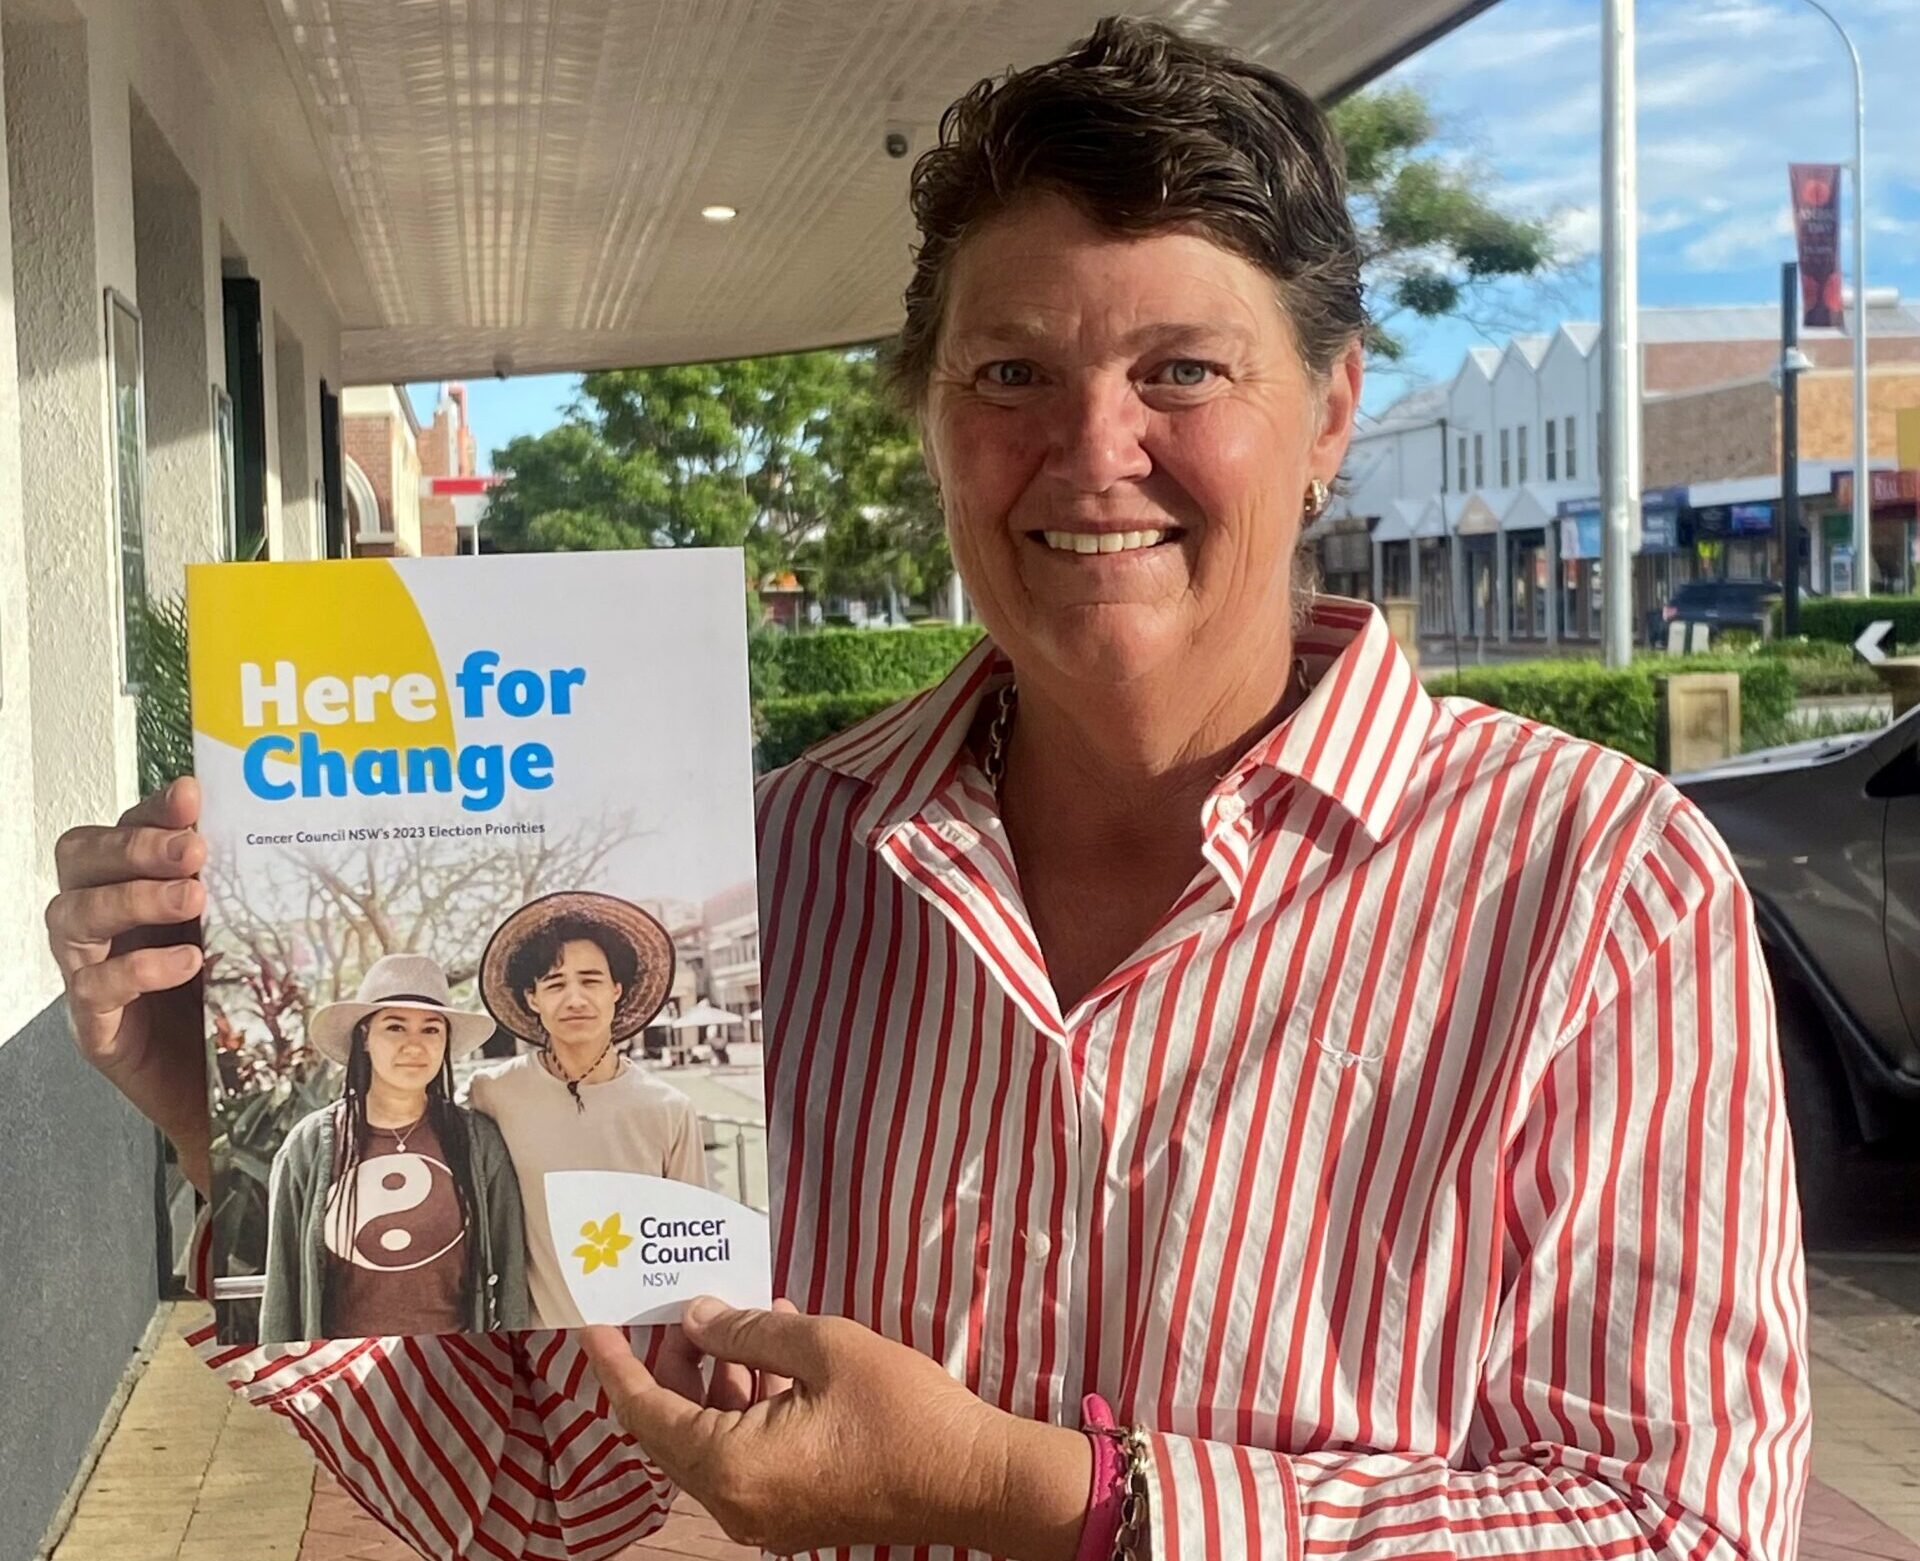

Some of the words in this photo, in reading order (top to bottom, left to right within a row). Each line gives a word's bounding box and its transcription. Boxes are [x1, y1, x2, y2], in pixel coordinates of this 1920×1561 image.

[240, 661, 437, 727] Here
[456, 650, 586, 718] for
[243, 732, 554, 812] Change
[246, 834, 293, 845] Cancer
[296, 829, 346, 843] Council
[348, 828, 389, 841] NSW's
[392, 826, 425, 839] 2023
[429, 825, 482, 837] Election
[485, 822, 545, 835] Priorities
[640, 1216, 726, 1239] Cancer
[641, 1238, 729, 1265] Council
[642, 1272, 680, 1287] NSW
